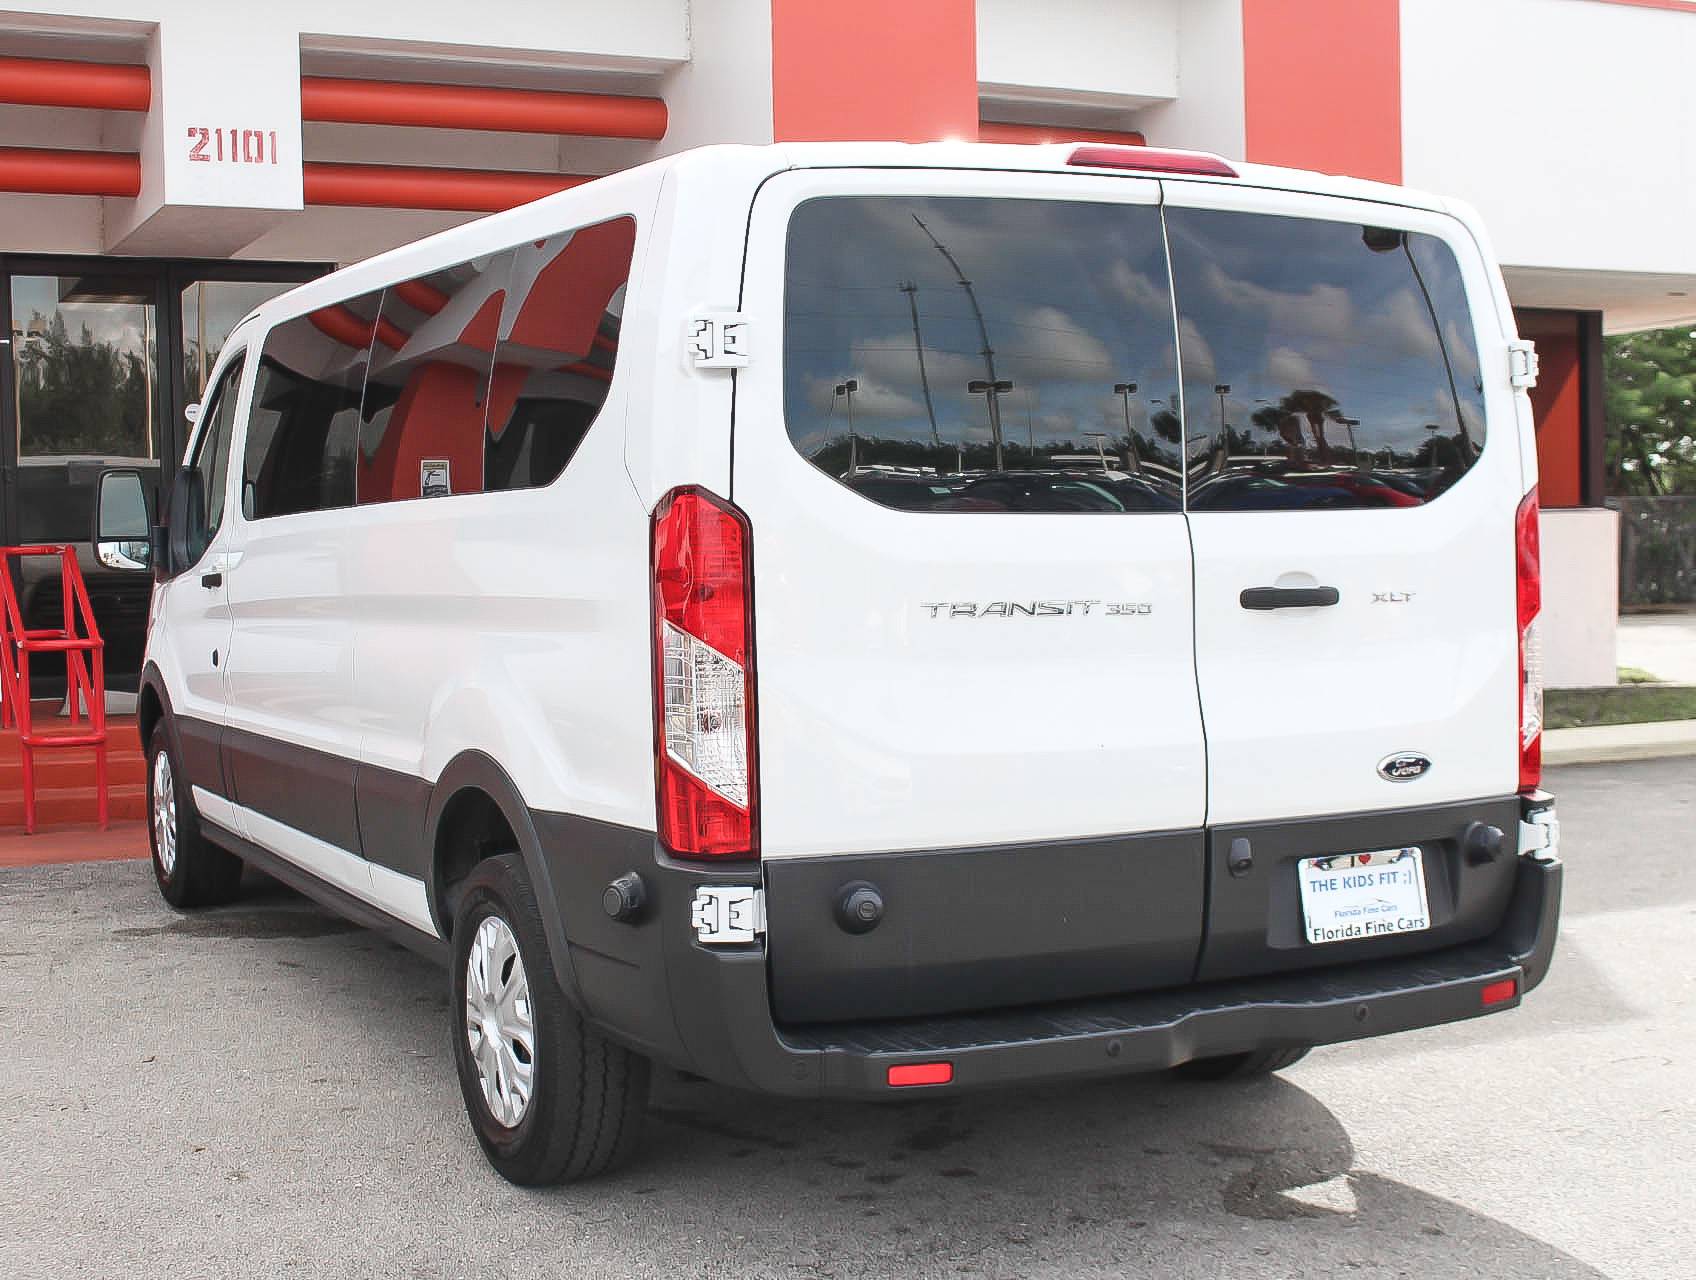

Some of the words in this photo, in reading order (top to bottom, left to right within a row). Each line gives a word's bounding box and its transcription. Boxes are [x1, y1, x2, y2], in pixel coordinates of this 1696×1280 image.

[187, 127, 277, 164] 21101
[920, 599, 1102, 618] TRANSIT
[1105, 602, 1153, 616] 350
[1370, 591, 1417, 605] XLT
[1310, 878, 1339, 893] THE
[1343, 874, 1374, 889] KIDS
[1379, 871, 1399, 885] FIT
[1314, 924, 1361, 941] Florida
[1365, 920, 1394, 935] Fine
[1397, 917, 1425, 931] Cars
